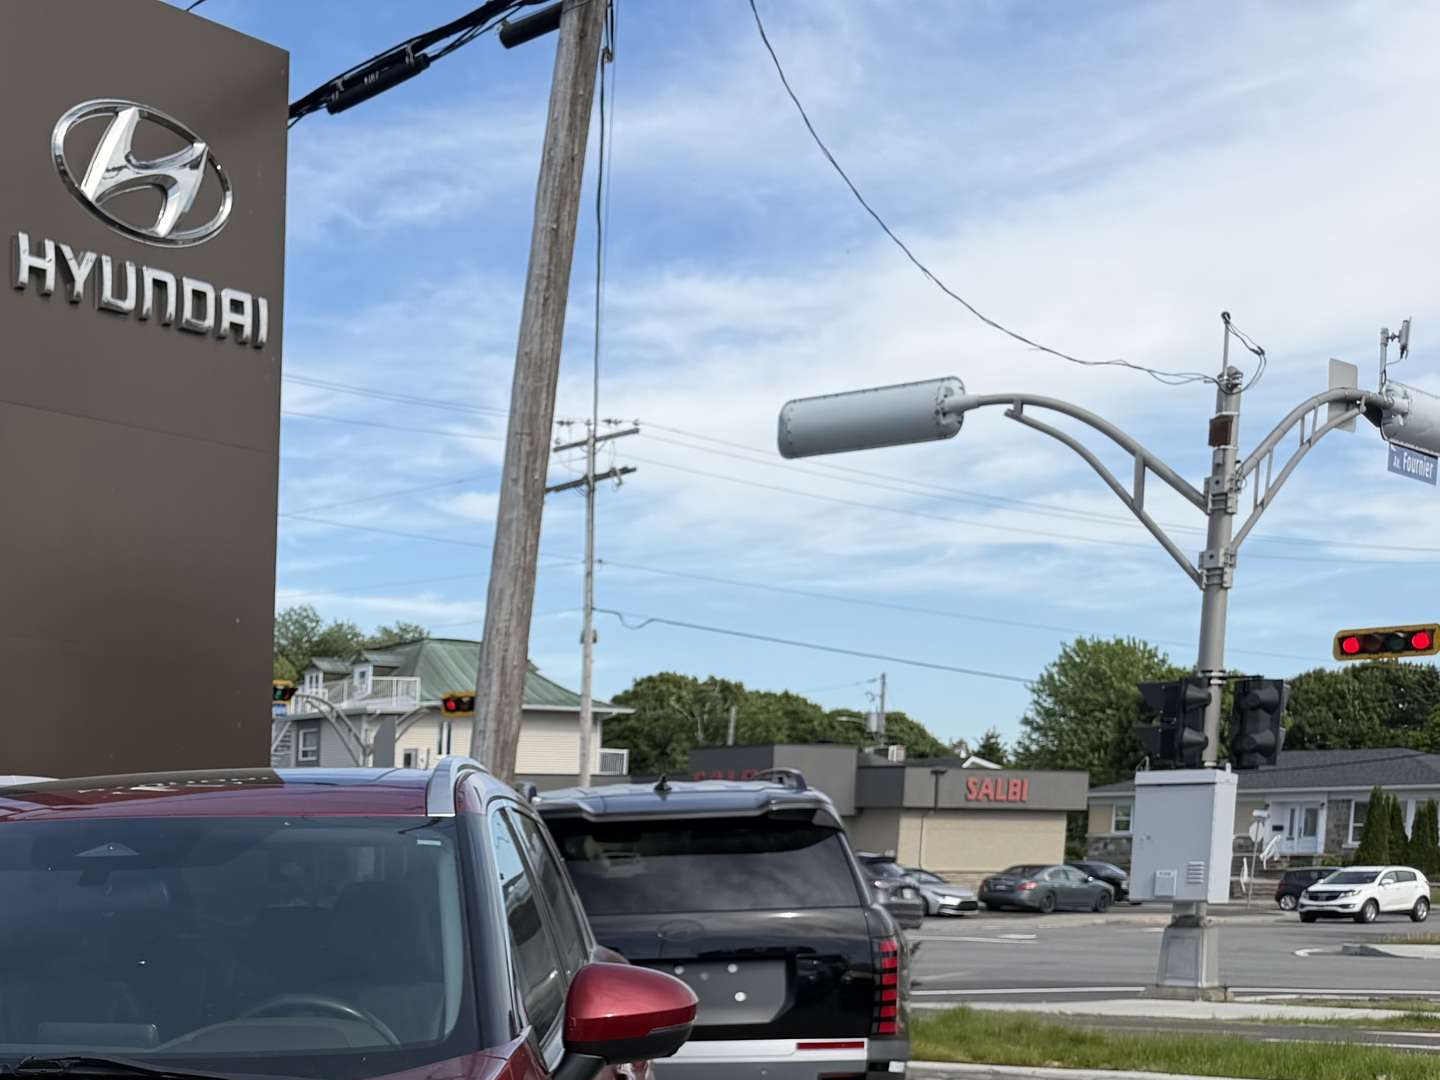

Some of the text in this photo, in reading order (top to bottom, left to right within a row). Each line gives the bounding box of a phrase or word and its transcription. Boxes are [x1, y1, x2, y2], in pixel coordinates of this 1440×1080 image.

[14, 232, 269, 349] HYUNDAI
[1403, 451, 1434, 478] Fournier
[965, 777, 1029, 802] SALBI
